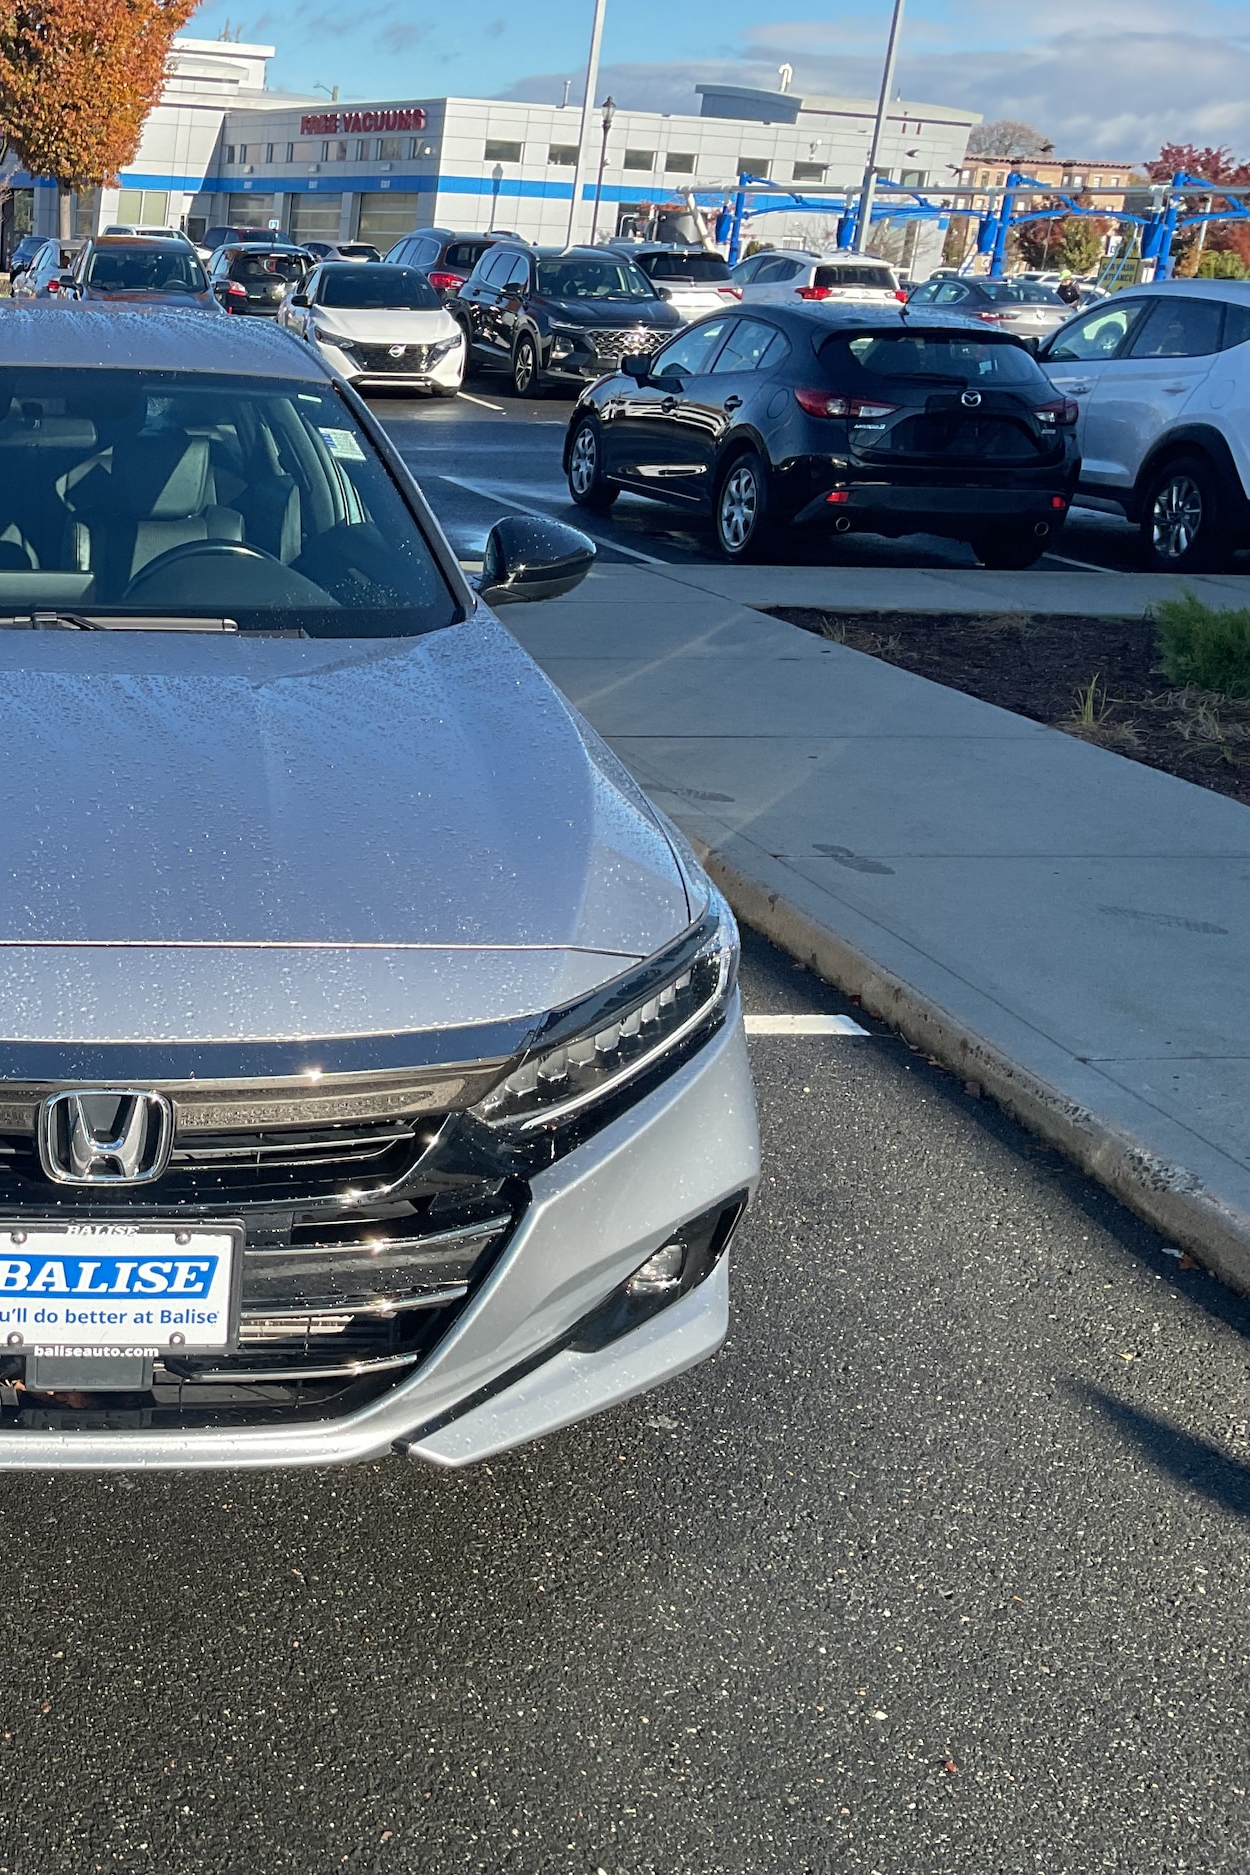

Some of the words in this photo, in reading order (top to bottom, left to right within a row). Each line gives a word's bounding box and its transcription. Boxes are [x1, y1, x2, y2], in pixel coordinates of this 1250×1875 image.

[300, 113, 340, 135] FREE
[343, 108, 427, 132] VACUUMS
[65, 1225, 140, 1237] BALISE
[34, 1308, 58, 1324] do
[65, 1308, 127, 1324] better
[135, 1310, 154, 1324] at
[160, 1309, 218, 1324] Balise
[34, 1345, 159, 1358] baliseauto.com
